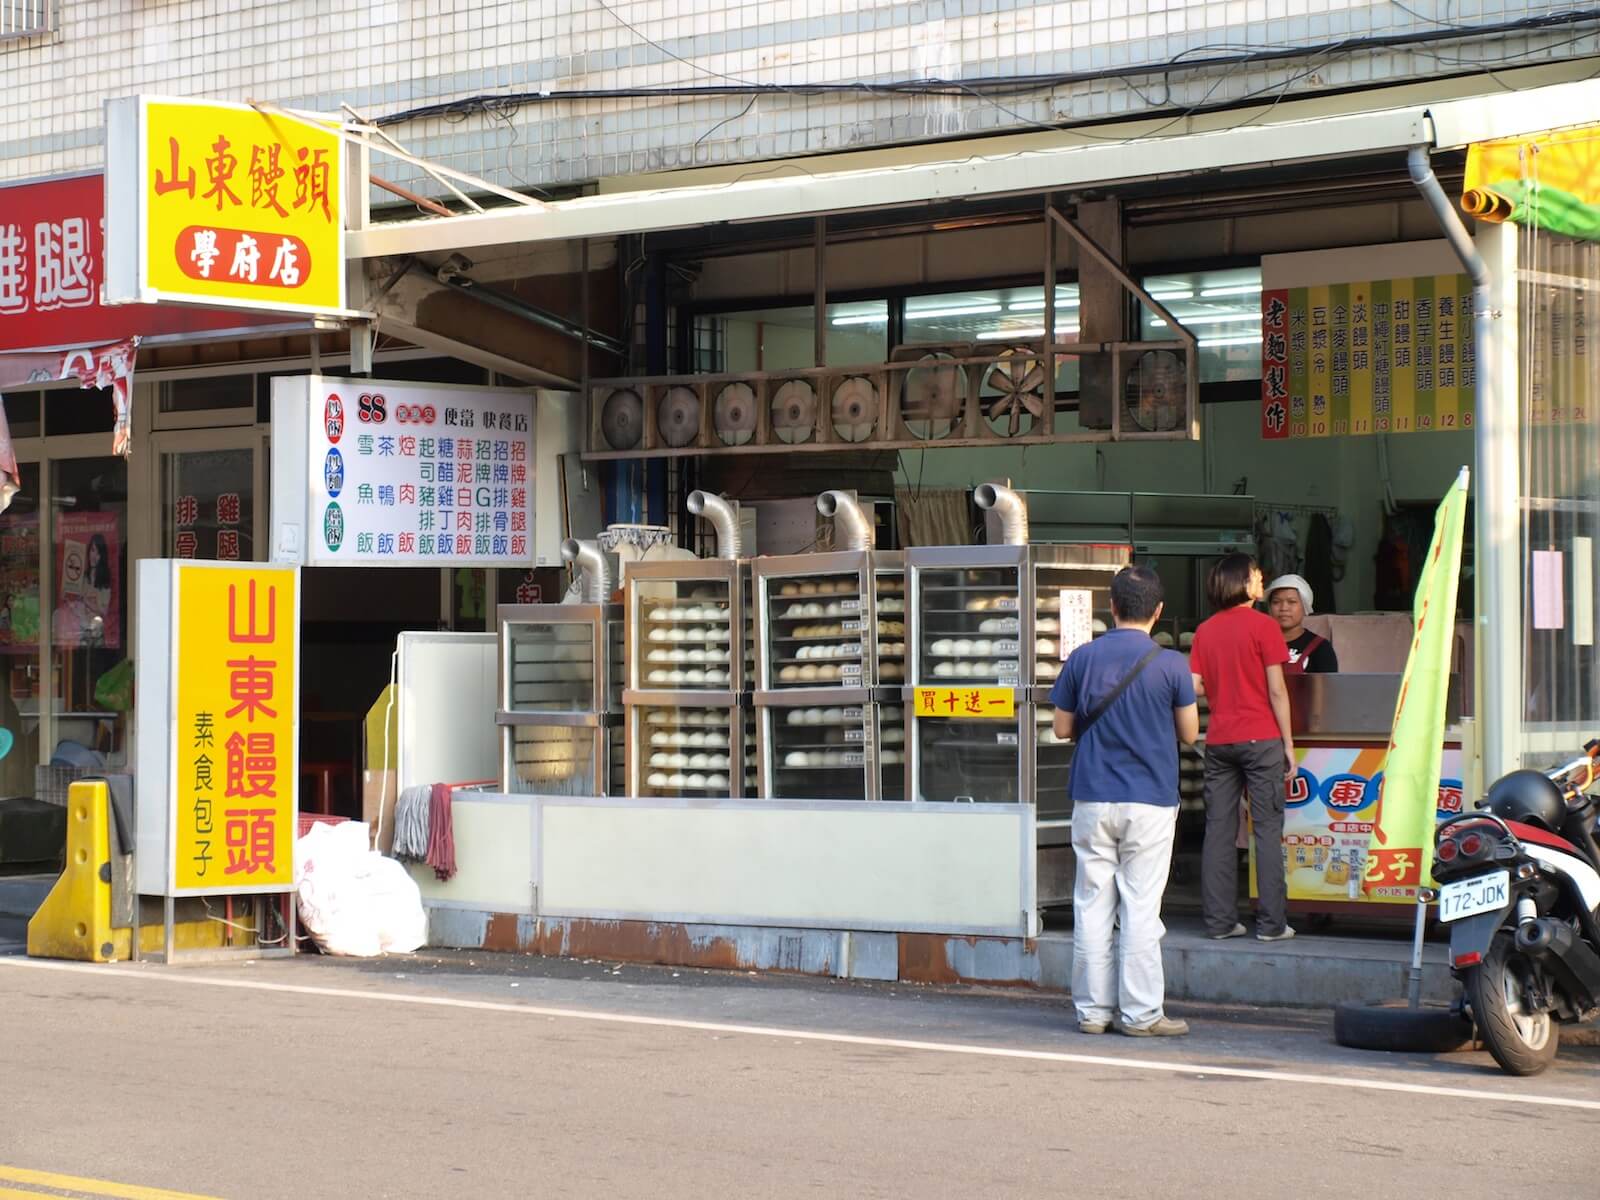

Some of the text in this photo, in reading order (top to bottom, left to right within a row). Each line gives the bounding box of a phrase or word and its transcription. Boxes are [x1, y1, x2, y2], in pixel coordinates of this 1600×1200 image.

[153, 134, 332, 224] 山東饅頭
[189, 229, 300, 285] 學府店
[1333, 304, 1348, 395] 全麥饅頭
[1353, 303, 1368, 370] 淡饅頭
[1395, 300, 1410, 367] 甜饅頭
[1416, 298, 1432, 390] 香芋饅頭
[1439, 296, 1455, 426] 養生饅頭 12
[359, 395, 386, 422] 88
[444, 407, 474, 427] 便當
[1312, 422, 1326, 434] 10
[1375, 418, 1389, 430] 13
[357, 434, 374, 553] 雪魚飯
[377, 436, 394, 554] 茶鴨飯
[418, 437, 435, 555] 起司豬排飯
[437, 437, 454, 555] 糖醋雞丁飯
[456, 439, 473, 555] 蒜泥白肉飯
[475, 440, 491, 555] 招牌G排飯
[493, 440, 509, 555] 招牌排骨飯
[511, 441, 527, 555] 招牌雞腿飯
[225, 579, 277, 875] 山東饅頭
[921, 690, 1006, 713] 買十送一
[193, 711, 214, 876] 素食包子
